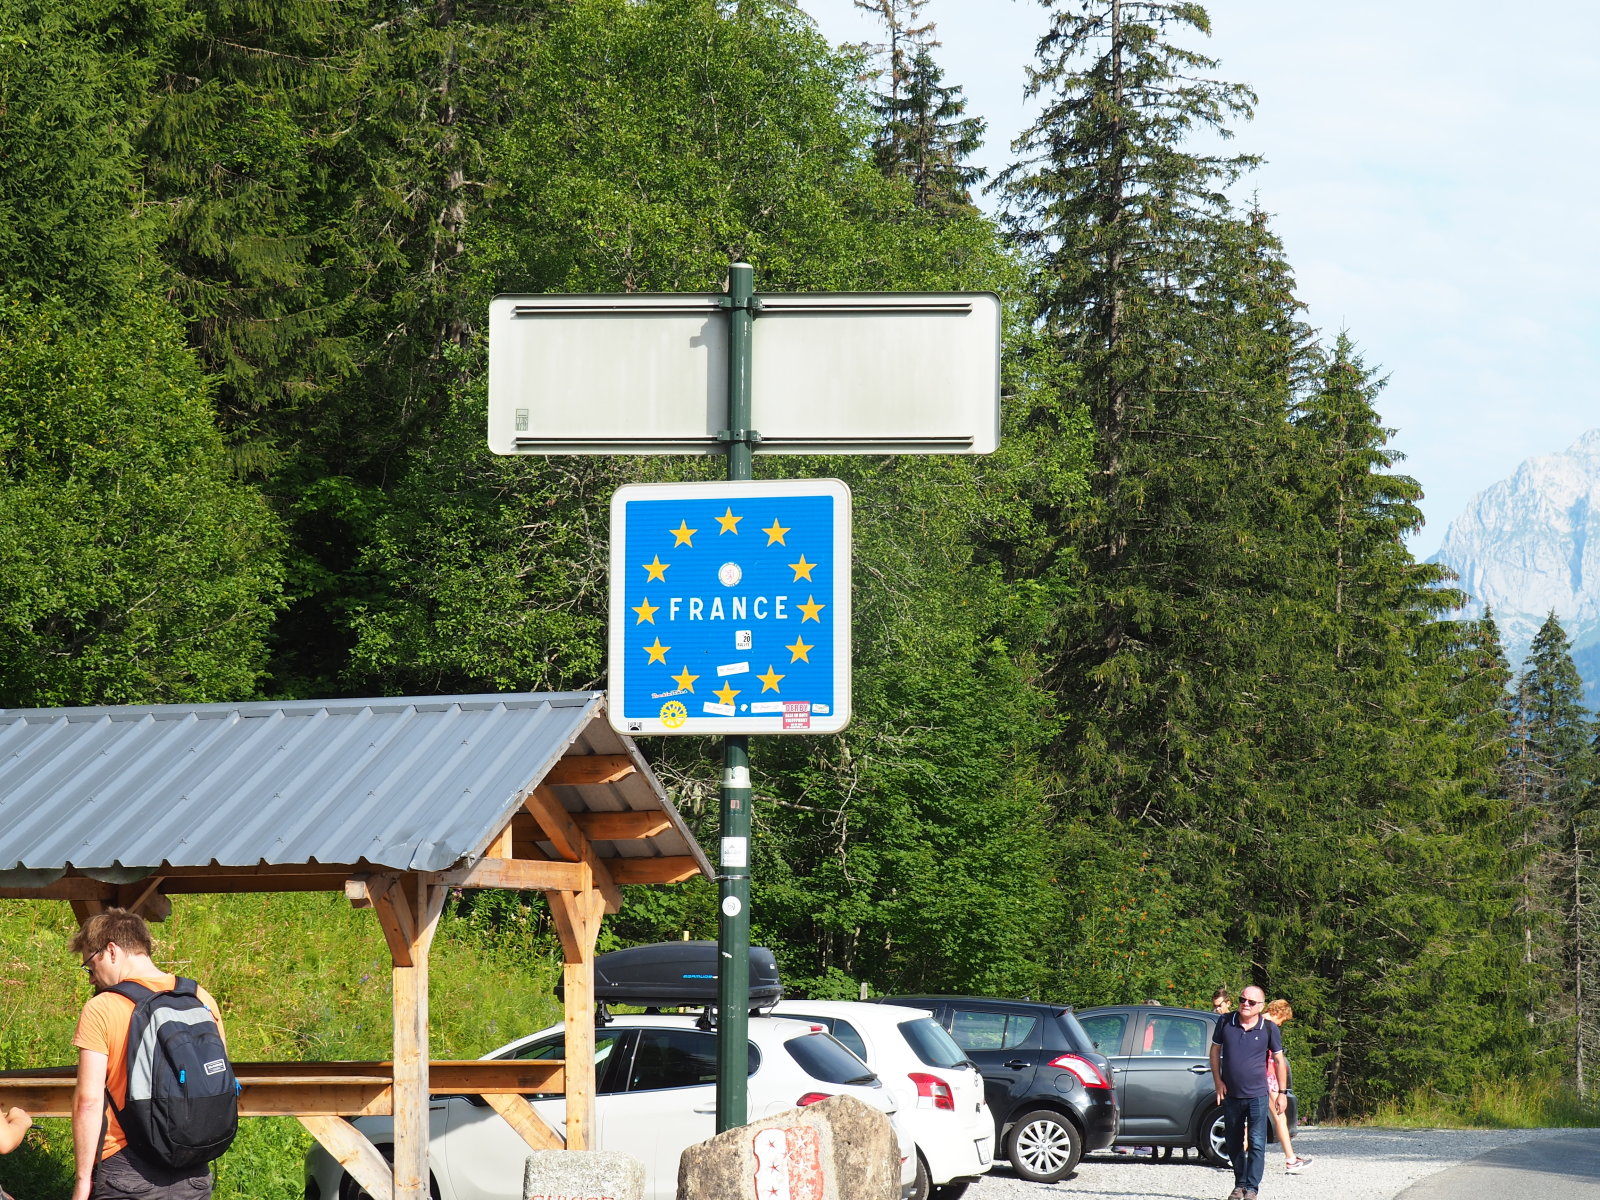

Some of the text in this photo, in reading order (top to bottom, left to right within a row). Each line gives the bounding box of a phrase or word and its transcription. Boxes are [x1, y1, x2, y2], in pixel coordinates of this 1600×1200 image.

[670, 596, 788, 621] FRANCE
[743, 635, 751, 643] 20
[785, 704, 808, 712] DERBY
